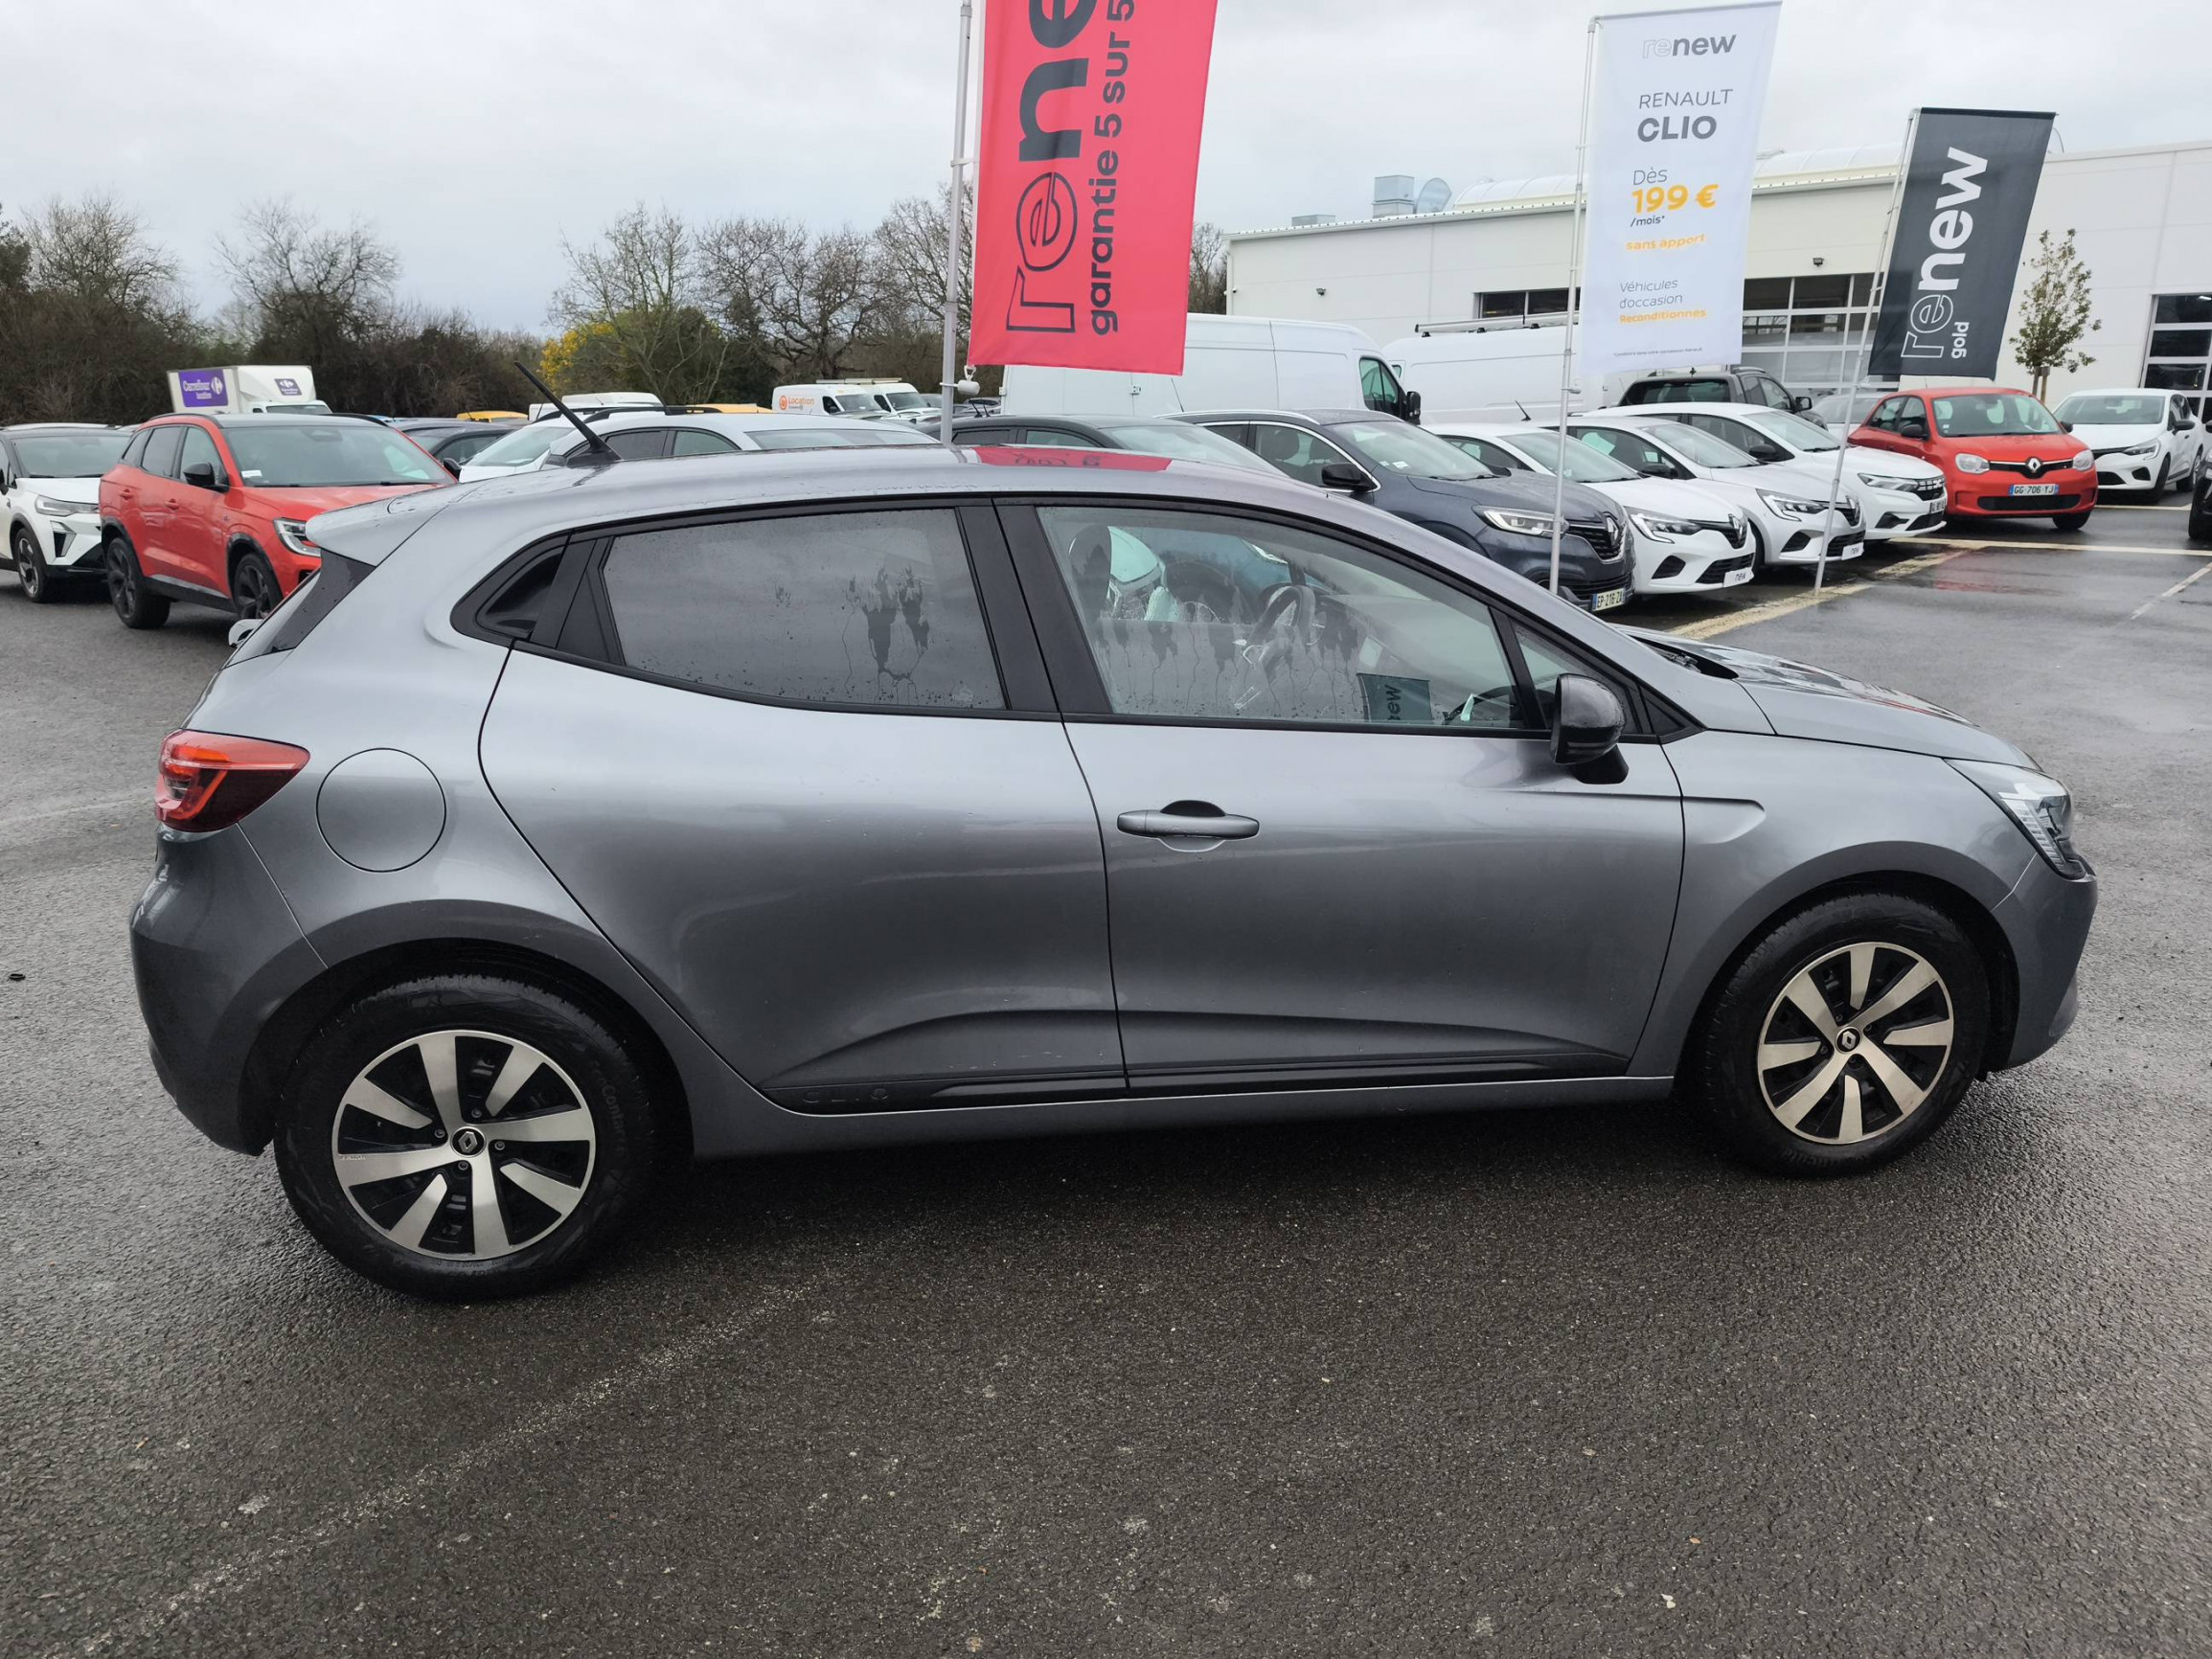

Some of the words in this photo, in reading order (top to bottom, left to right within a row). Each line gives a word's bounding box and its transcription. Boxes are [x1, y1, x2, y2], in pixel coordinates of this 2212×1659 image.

[1106, 0, 1134, 21] 5
[1641, 34, 1737, 58] renew
[1102, 31, 1130, 104] sur
[1639, 88, 1734, 109] RENAULT
[1094, 113, 1122, 138] 5
[1637, 115, 1718, 142] CLIO
[1632, 167, 1668, 186] Dès
[1631, 184, 1689, 214] 199
[1695, 183, 1720, 209] €
[1088, 150, 1119, 335] garantie
[1625, 239, 1656, 251] sans
[1659, 234, 1705, 249] apport
[1901, 147, 1989, 359] renew
[1619, 279, 1678, 293] Véhicules
[1950, 321, 1970, 359] gold
